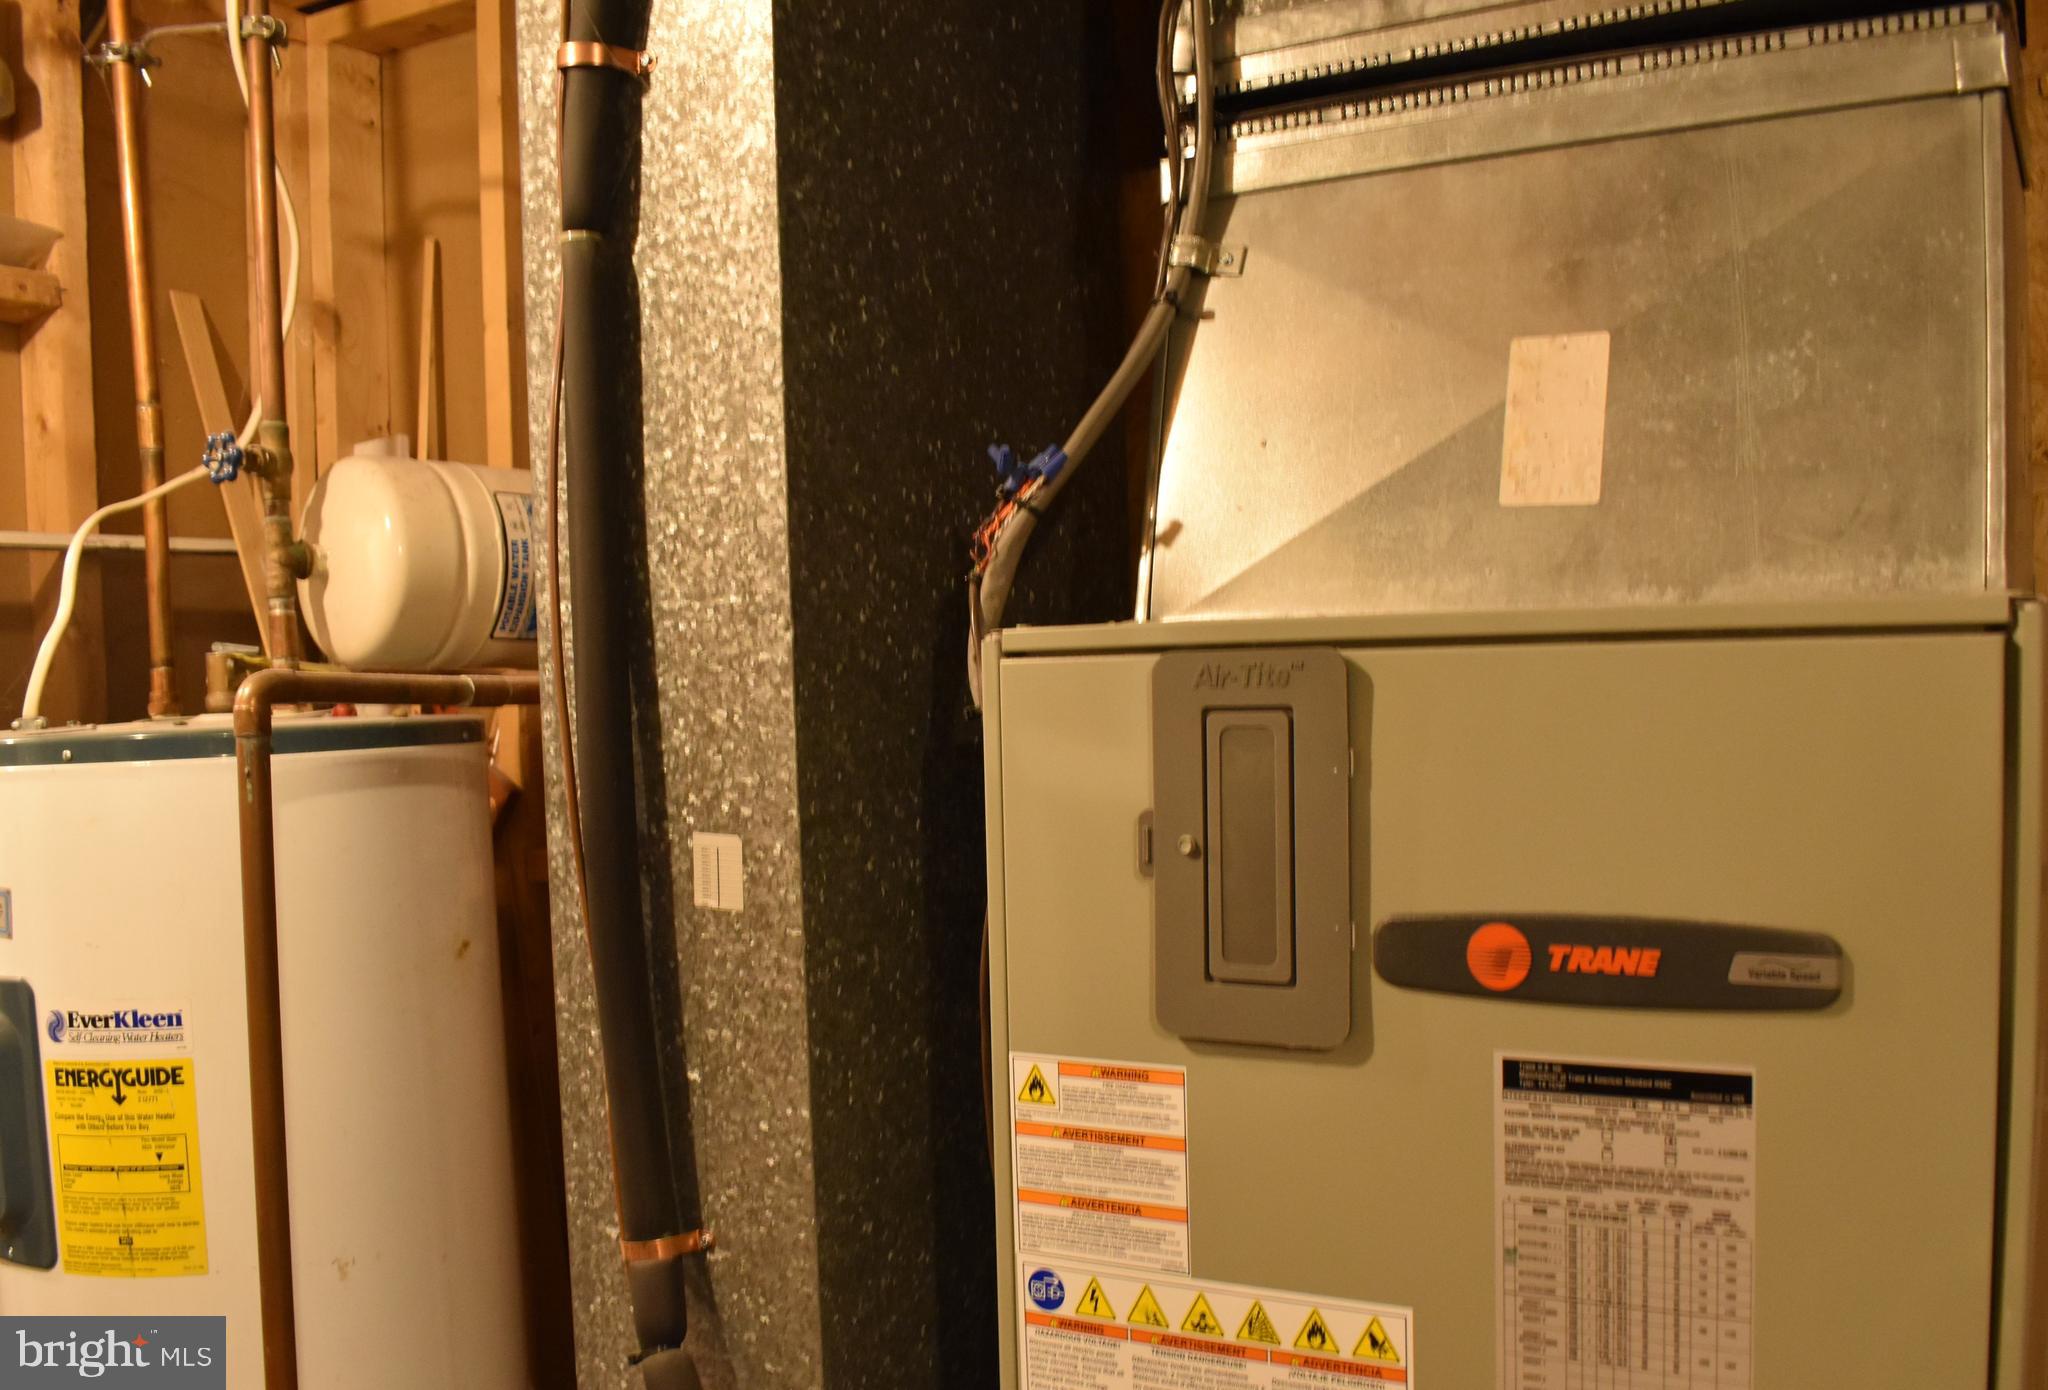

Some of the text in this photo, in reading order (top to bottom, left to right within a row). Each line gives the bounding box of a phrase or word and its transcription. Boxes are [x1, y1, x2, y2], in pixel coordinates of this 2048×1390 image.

[511, 538, 519, 579] WATER
[521, 538, 529, 569] TANK
[1549, 944, 1661, 977] TRANE
[67, 1009, 183, 1028] EverKleen
[122, 1032, 147, 1042] Water
[150, 1031, 184, 1042] Heaters
[1100, 1066, 1149, 1082] WARNING
[1062, 1127, 1146, 1146] AVERTISSEMENT
[1070, 1197, 1142, 1216] ADVERTENCIA
[1059, 1317, 1105, 1335] WARNING
[1160, 1333, 1247, 1358] AVERTISSEMENT
[1303, 1357, 1383, 1379] ADVERTENCIA
